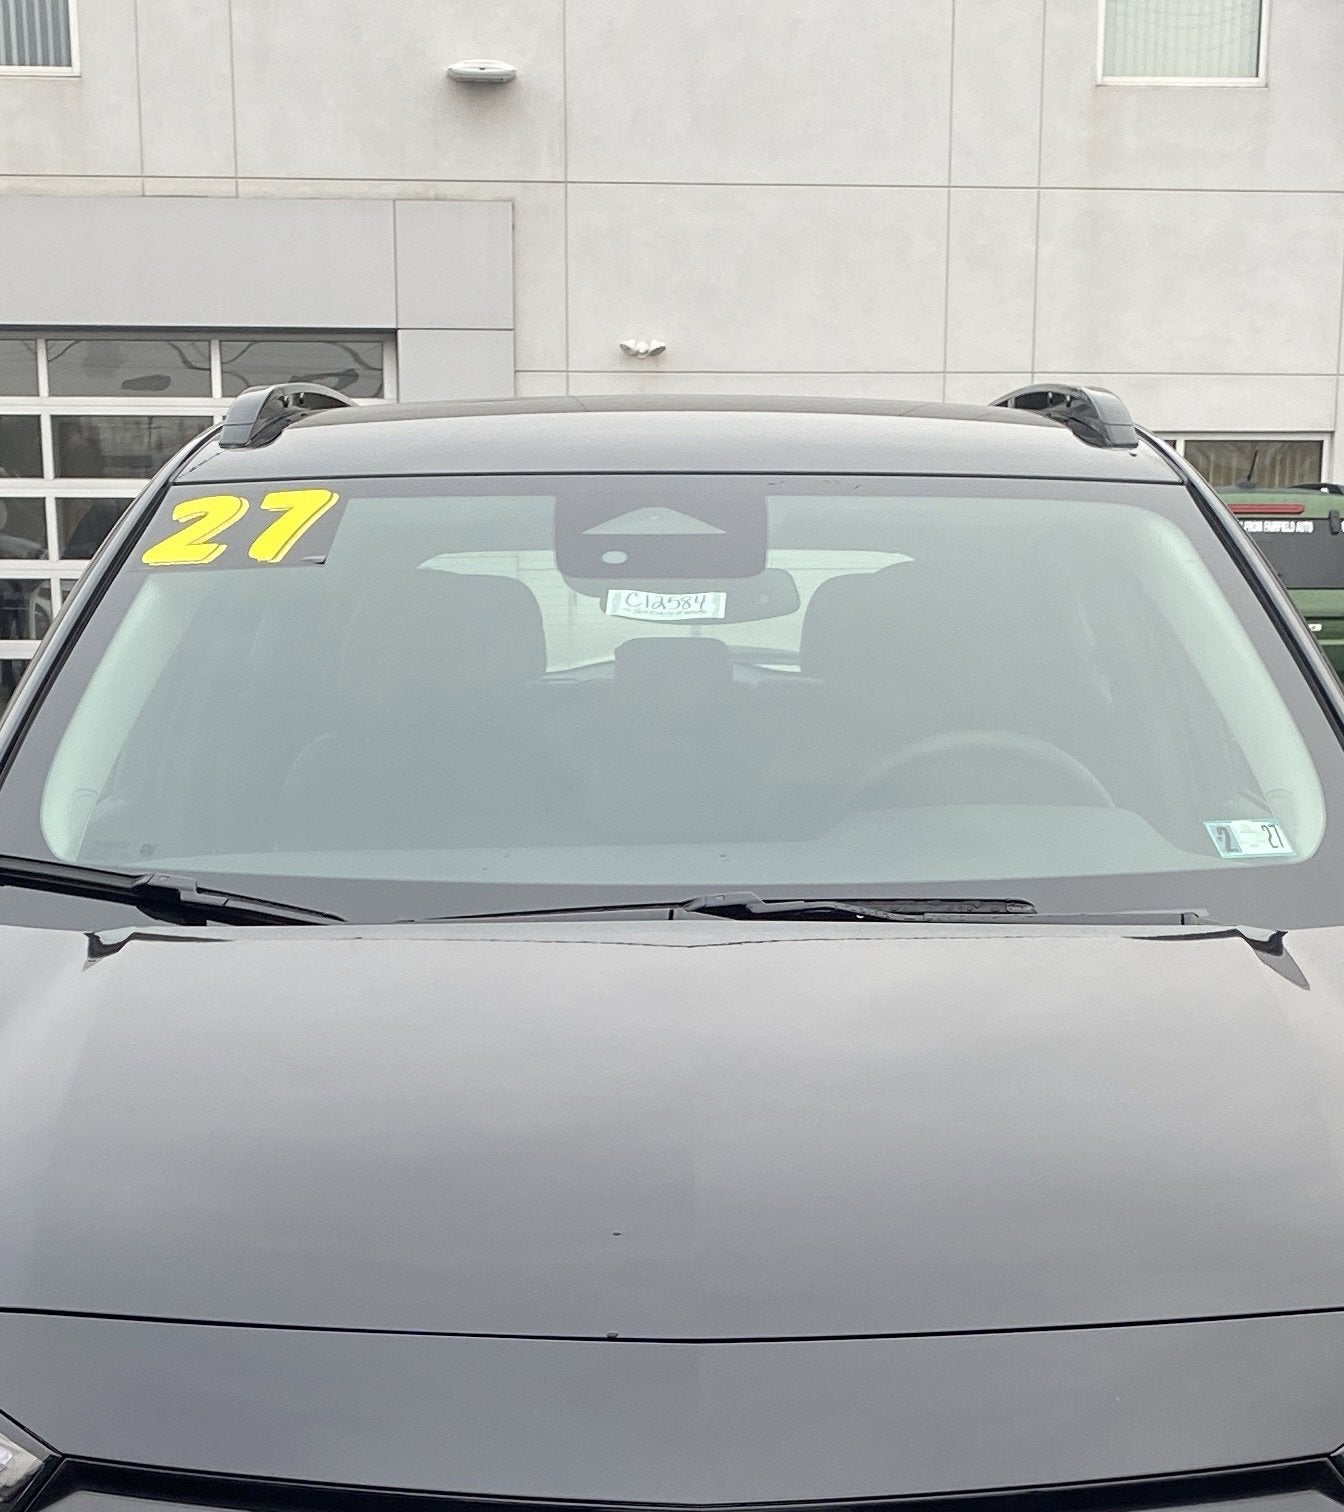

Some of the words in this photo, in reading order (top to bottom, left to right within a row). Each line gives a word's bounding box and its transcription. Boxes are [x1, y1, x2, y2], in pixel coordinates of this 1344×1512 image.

[141, 488, 340, 566] 27
[624, 591, 707, 611] C12584
[1260, 823, 1285, 849] 27
